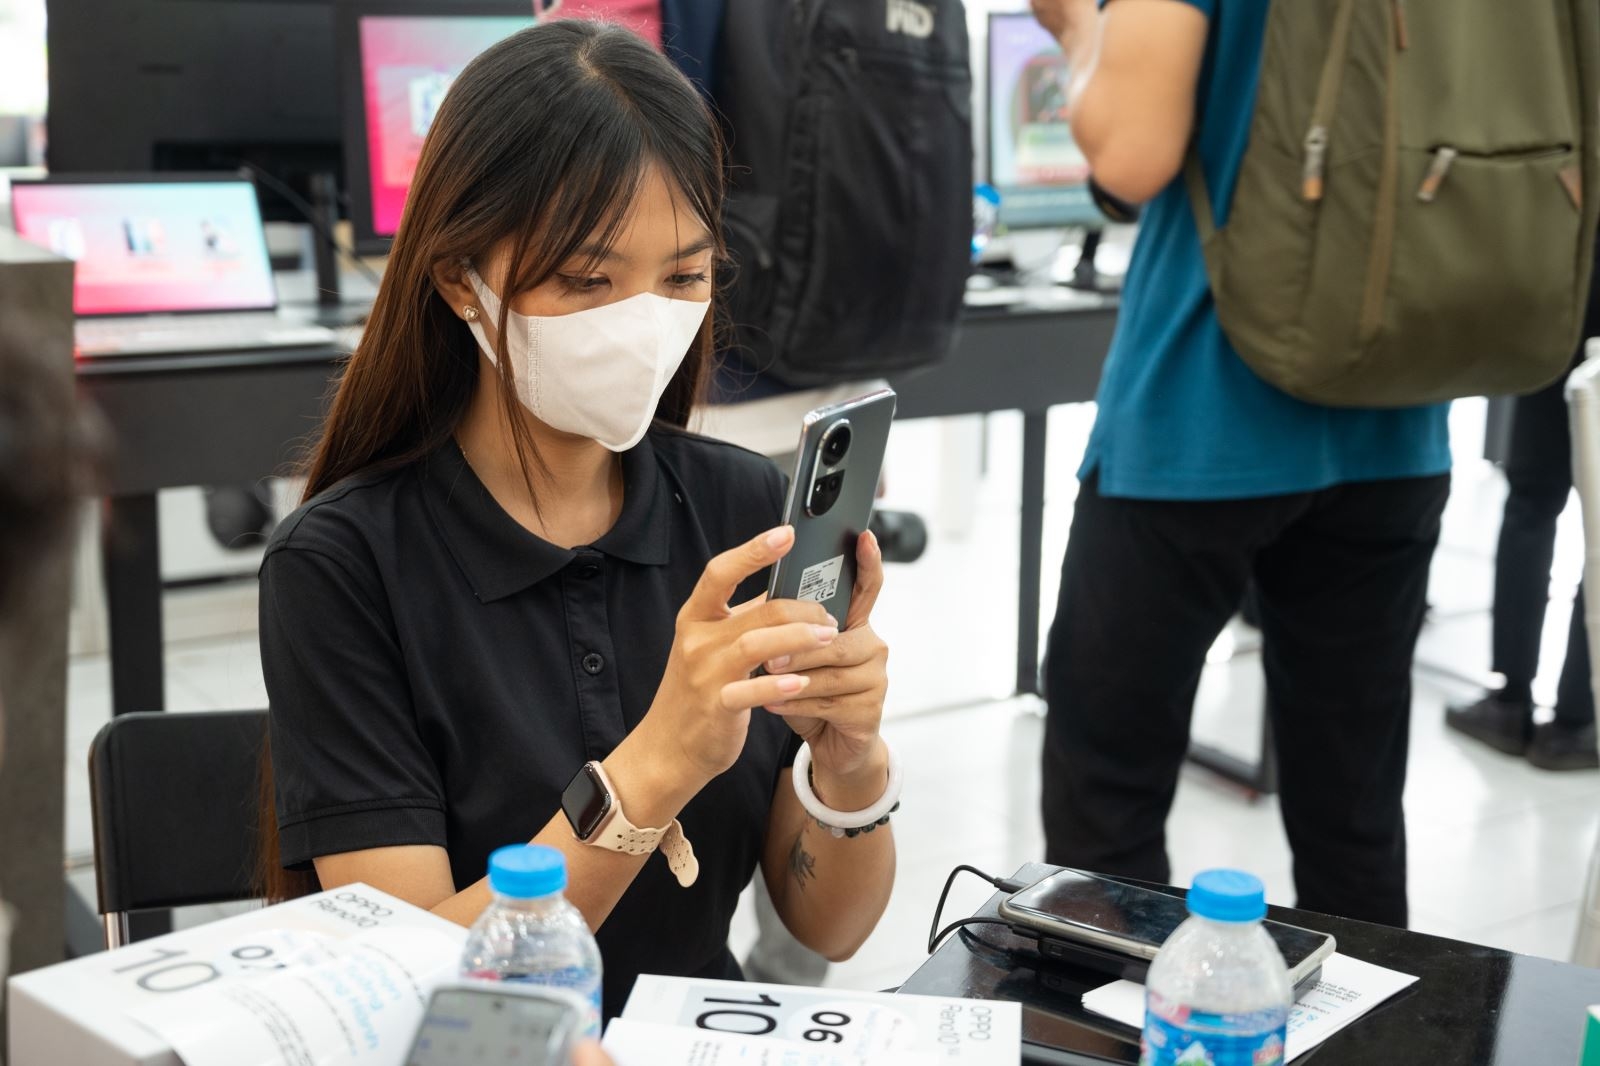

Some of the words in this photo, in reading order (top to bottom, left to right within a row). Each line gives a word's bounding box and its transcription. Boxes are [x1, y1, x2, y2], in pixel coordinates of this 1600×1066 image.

[310, 898, 379, 928] Reno10
[335, 892, 393, 917] OPPO
[112, 948, 222, 993] 10
[695, 994, 782, 1036] 10
[803, 1011, 852, 1044] 06
[937, 1004, 962, 1044] Reno10
[968, 1005, 992, 1041] OPPO
